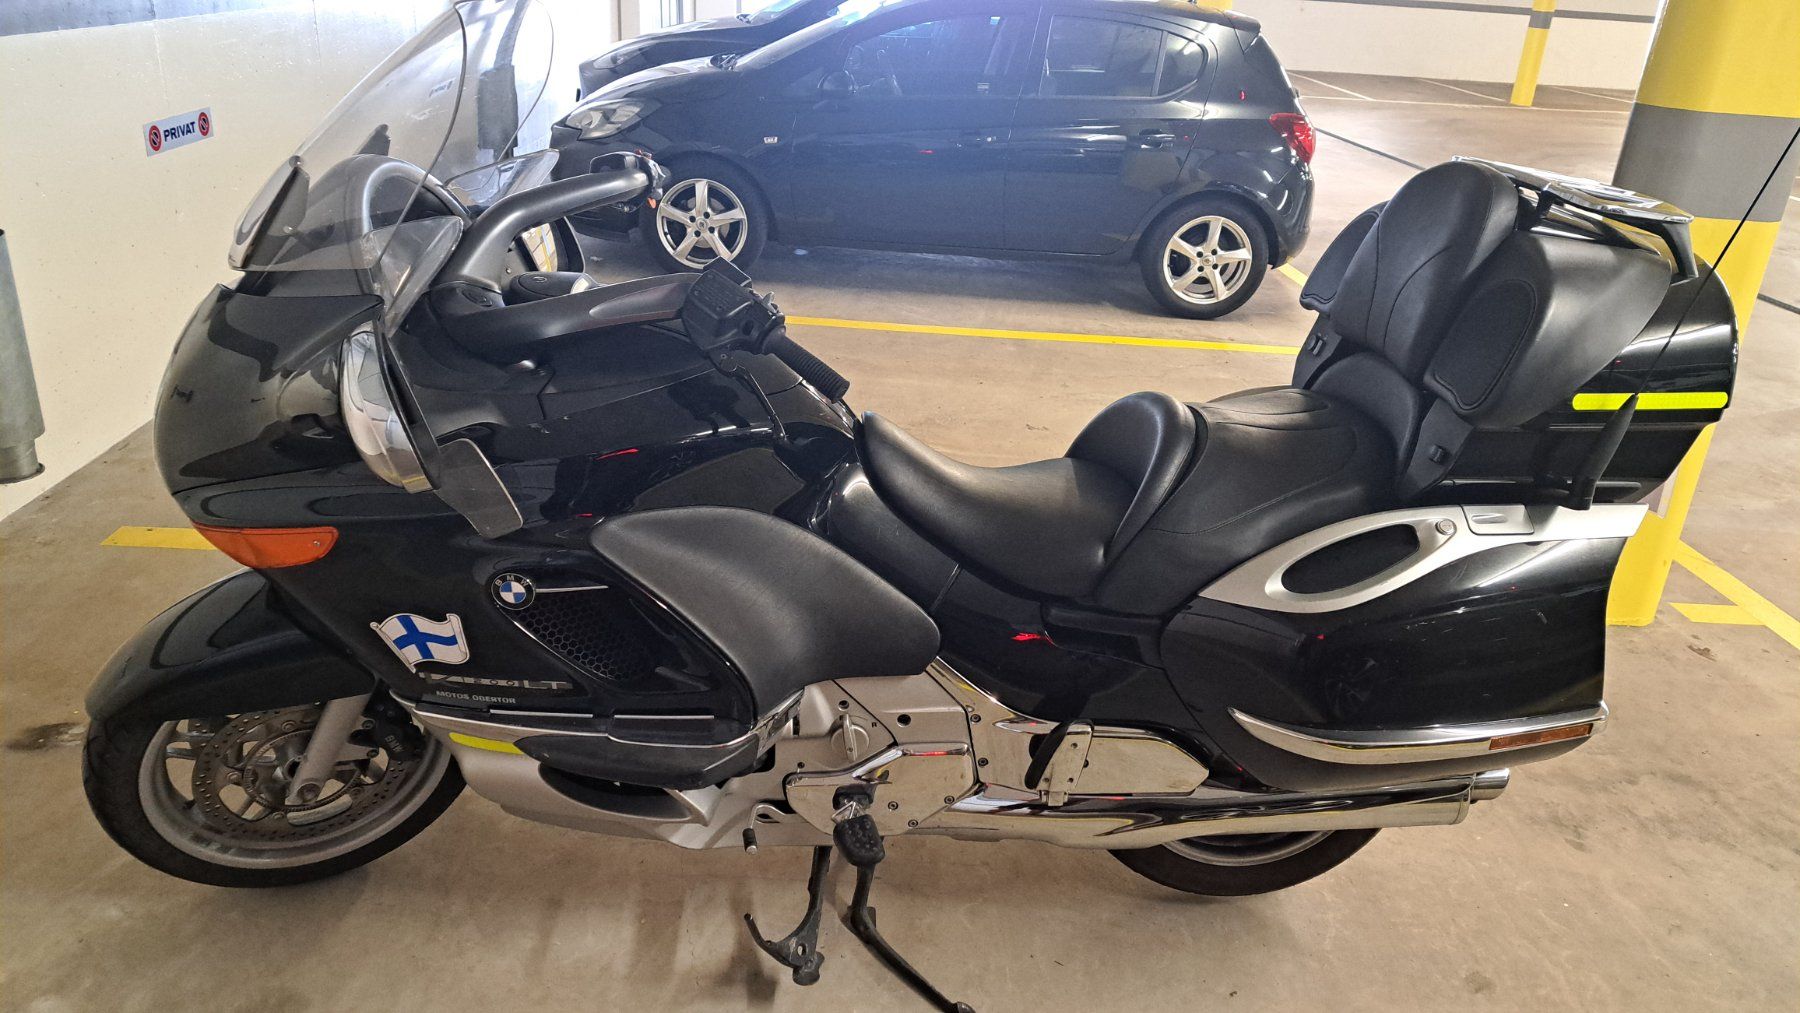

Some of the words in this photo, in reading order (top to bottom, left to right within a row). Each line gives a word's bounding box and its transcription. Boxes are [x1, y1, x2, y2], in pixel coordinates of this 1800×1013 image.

[163, 121, 196, 142] PRIVAT
[494, 574, 529, 587] BMW
[435, 690, 470, 700] MOTOS
